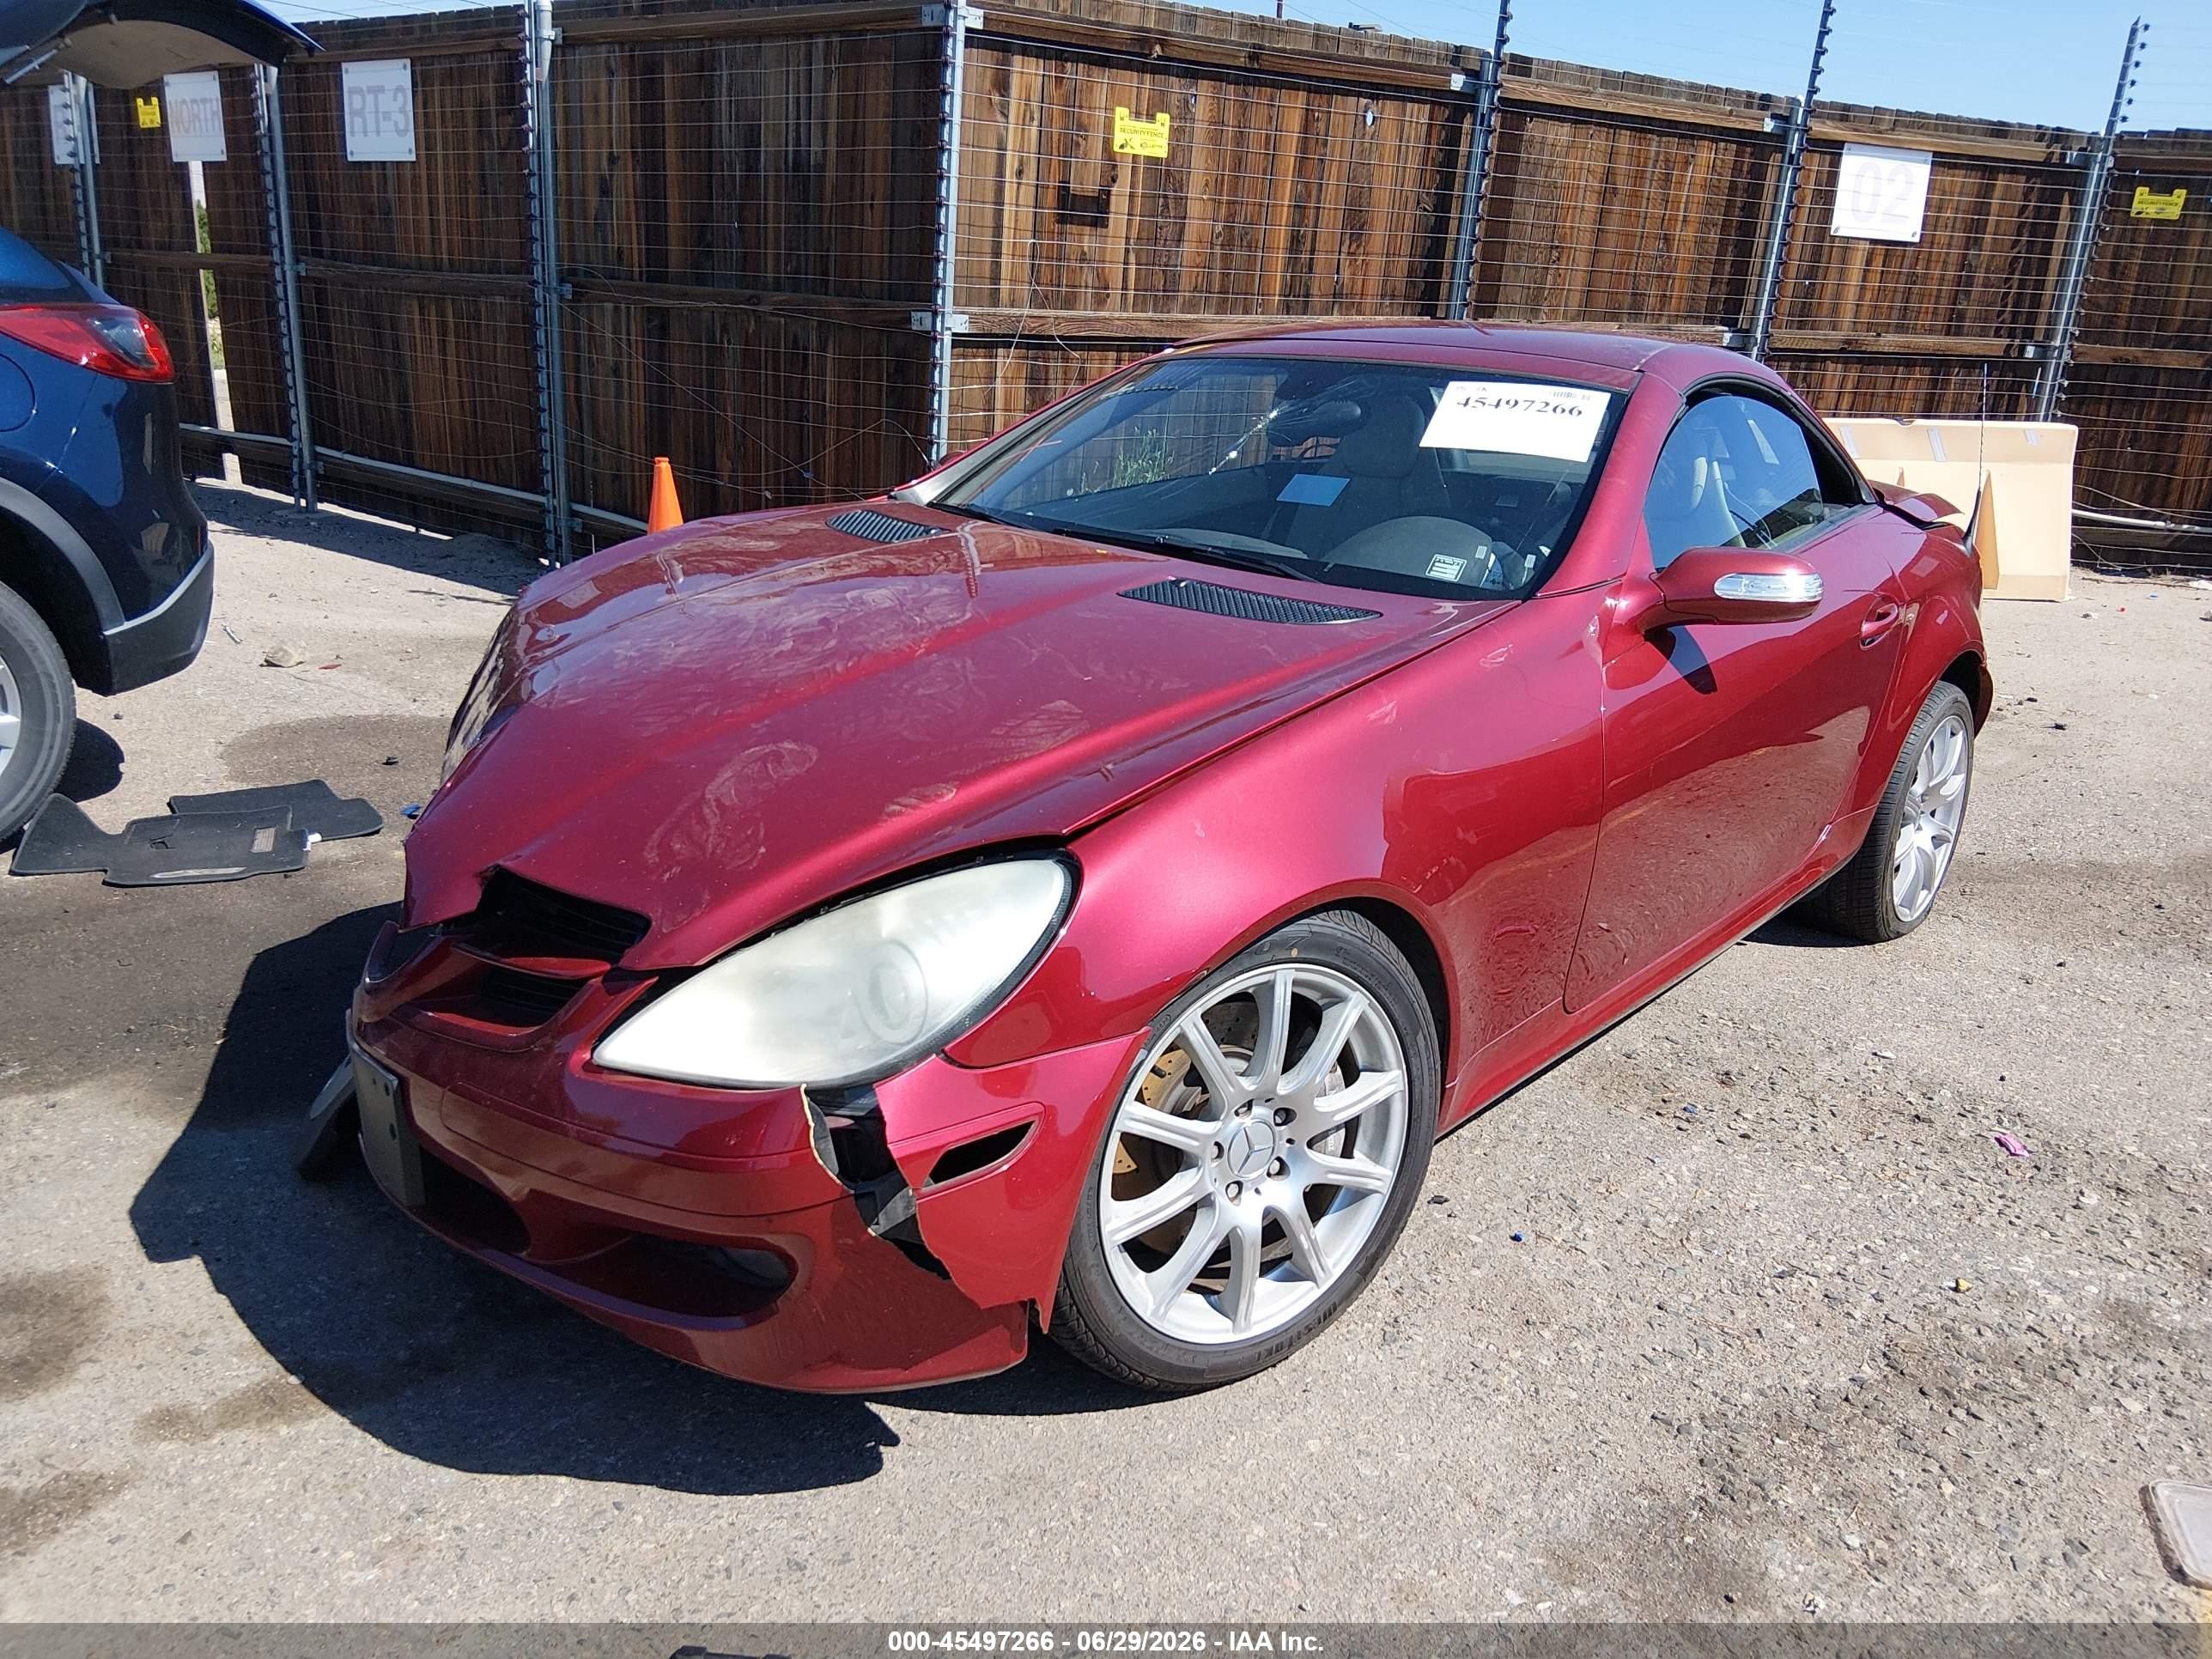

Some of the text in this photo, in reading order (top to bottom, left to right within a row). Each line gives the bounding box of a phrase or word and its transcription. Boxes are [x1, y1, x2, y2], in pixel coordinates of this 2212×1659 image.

[169, 97, 222, 135] NORTH
[348, 84, 410, 137] RT-3
[1851, 161, 1914, 224] 02
[1456, 396, 1583, 417] 45497266
